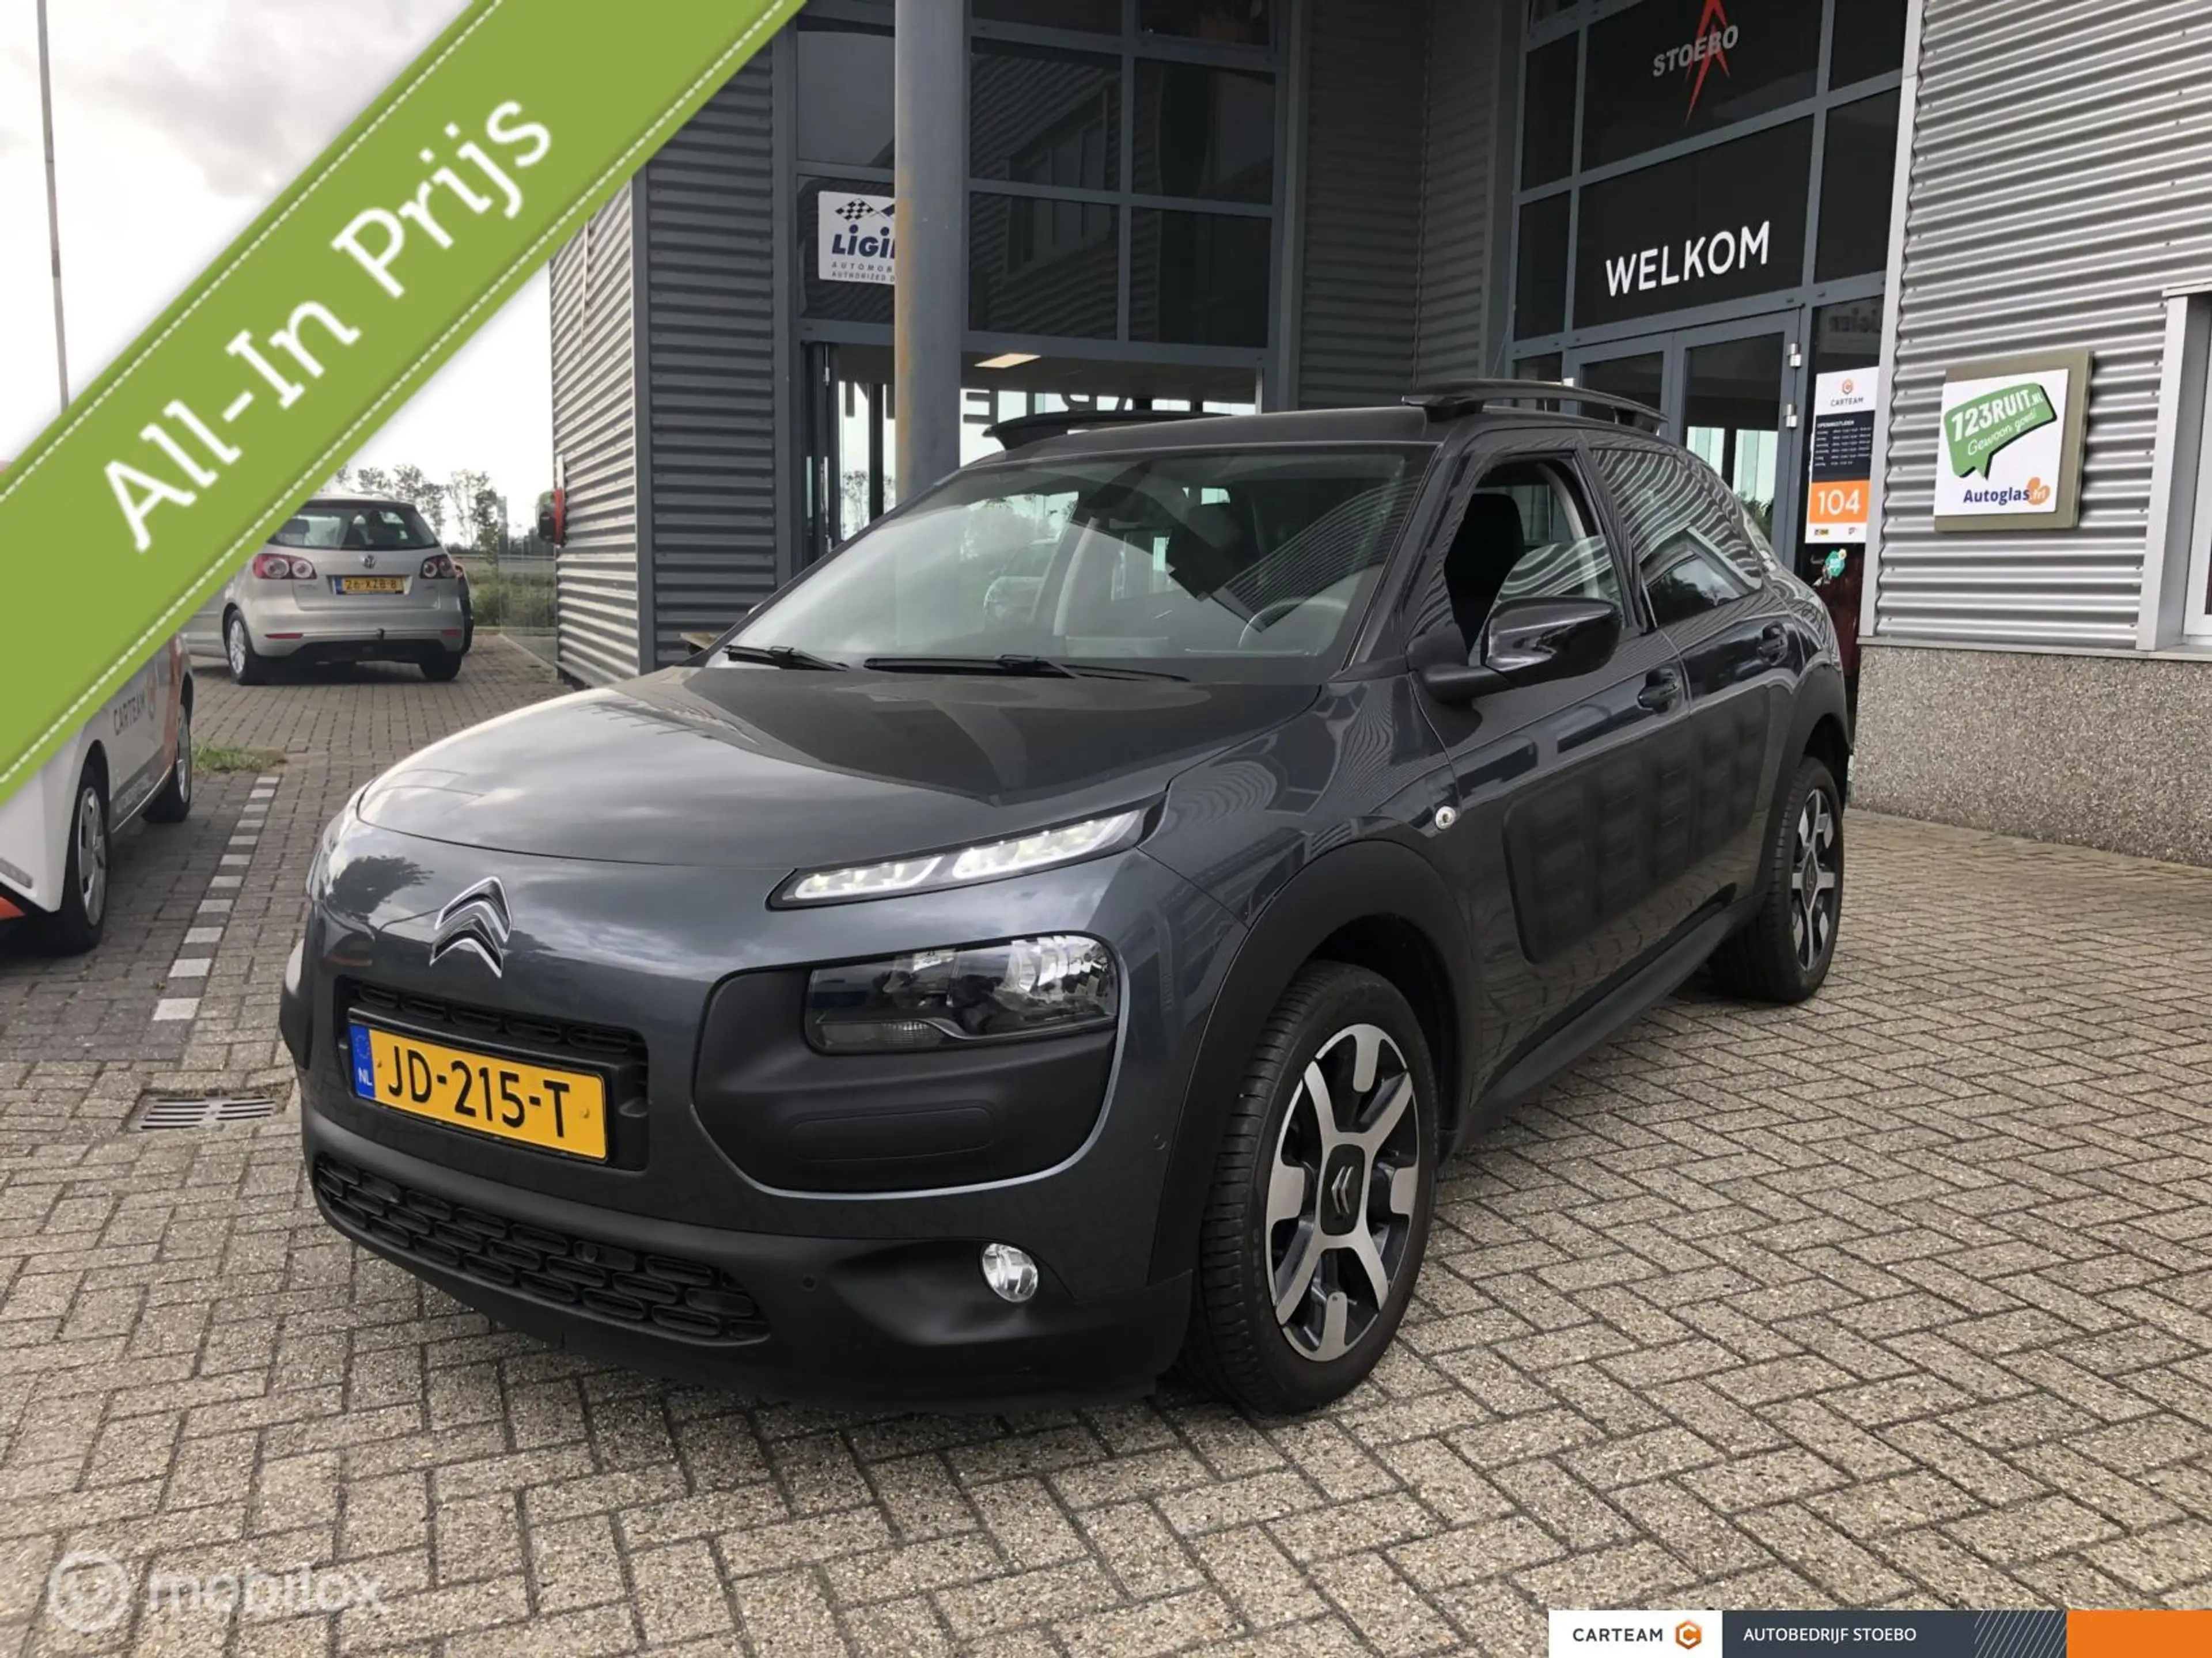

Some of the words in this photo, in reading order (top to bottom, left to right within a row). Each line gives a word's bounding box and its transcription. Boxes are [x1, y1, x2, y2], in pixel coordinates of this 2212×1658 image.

[1652, 25, 1739, 77] STOEBO
[1605, 221, 1770, 297] WELKOM
[1830, 396, 1864, 407] CARTEAM
[1967, 424, 2013, 456] Gewoon
[1817, 488, 1861, 515] 104
[113, 688, 145, 736] CARTEAM
[358, 1067, 373, 1086] NL
[387, 1046, 570, 1138] JD-215-T
